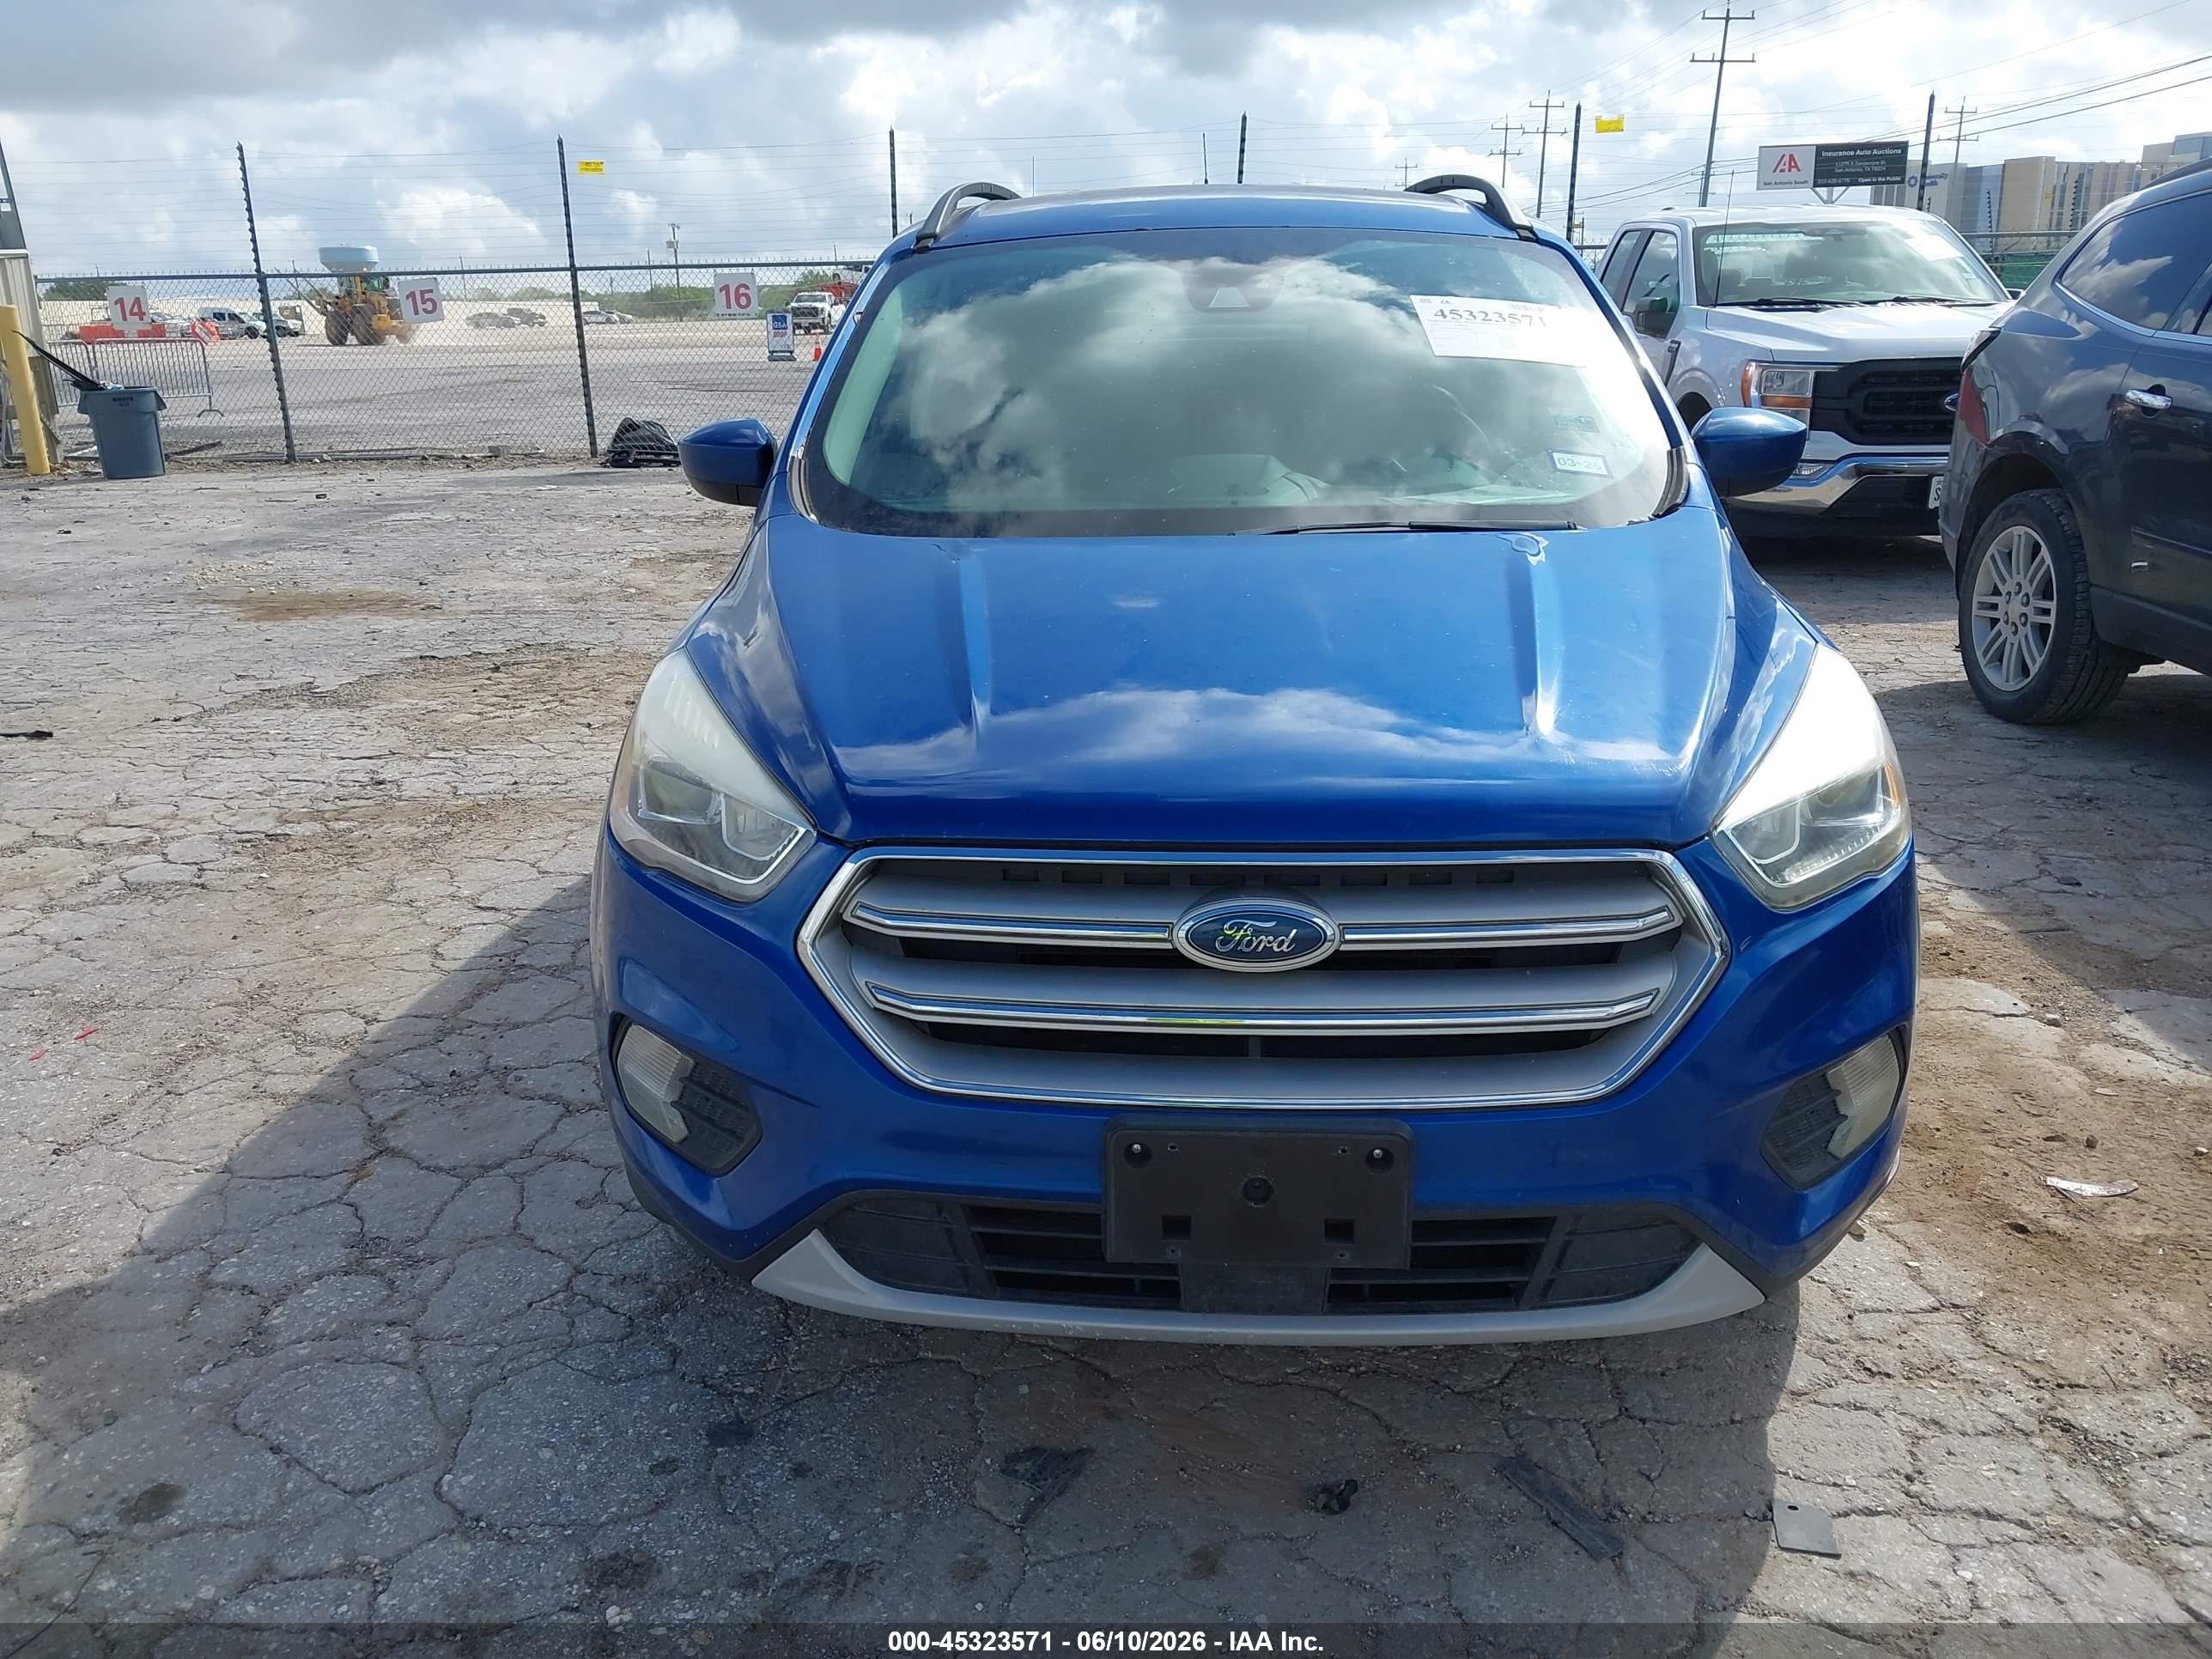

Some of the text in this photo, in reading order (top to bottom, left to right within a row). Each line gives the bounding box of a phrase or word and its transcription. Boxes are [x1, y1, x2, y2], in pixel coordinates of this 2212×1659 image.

[113, 296, 146, 322] 14
[404, 289, 438, 316] 15
[719, 283, 752, 310] 16
[1214, 918, 1298, 953] Ford
